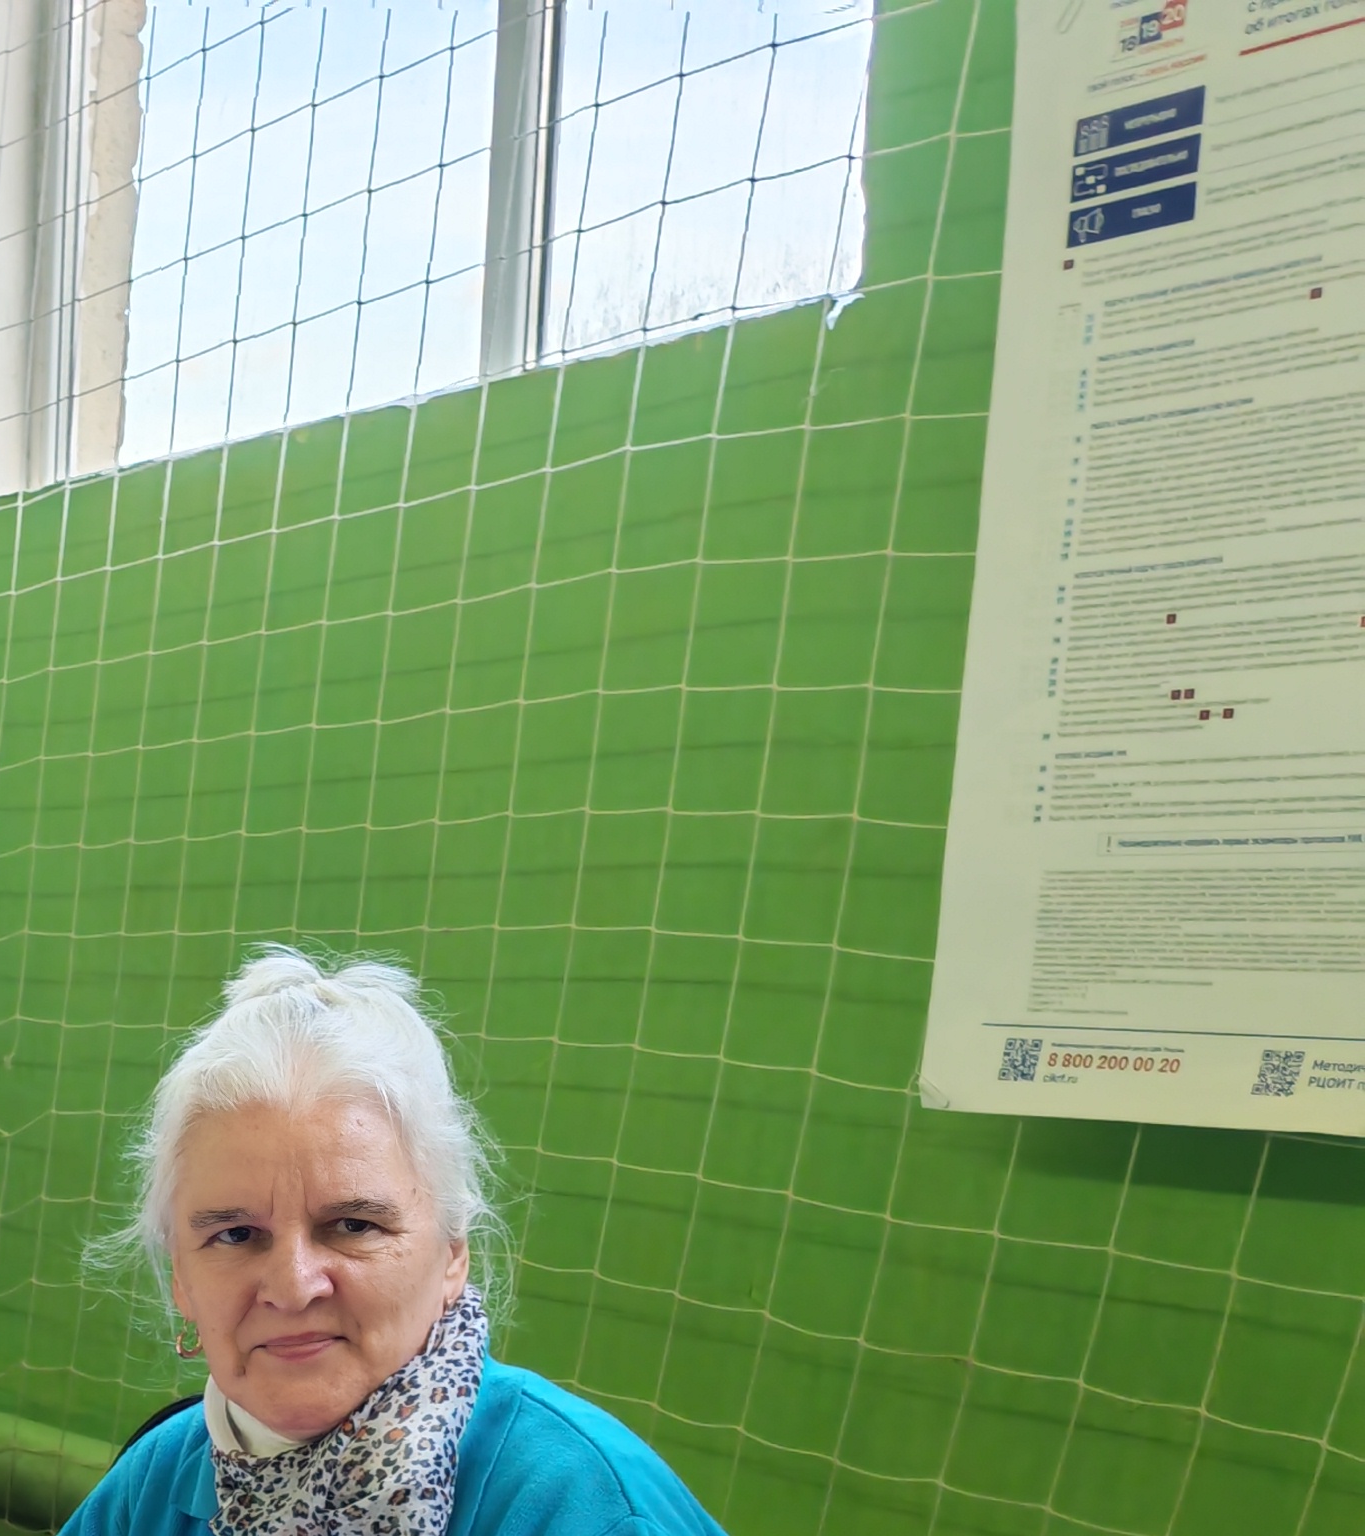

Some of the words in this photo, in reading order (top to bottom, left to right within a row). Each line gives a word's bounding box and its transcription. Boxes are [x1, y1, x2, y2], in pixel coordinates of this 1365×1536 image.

[1142, 20, 1159, 38] 19
[1162, 5, 1185, 24] 20
[1048, 1053, 1058, 1067] 8
[1062, 1053, 1093, 1068] 800
[1096, 1055, 1129, 1070] 200
[1133, 1057, 1155, 1071] 00
[1158, 1058, 1181, 1073] 20
[1308, 1076, 1355, 1089] РЦОИТ
